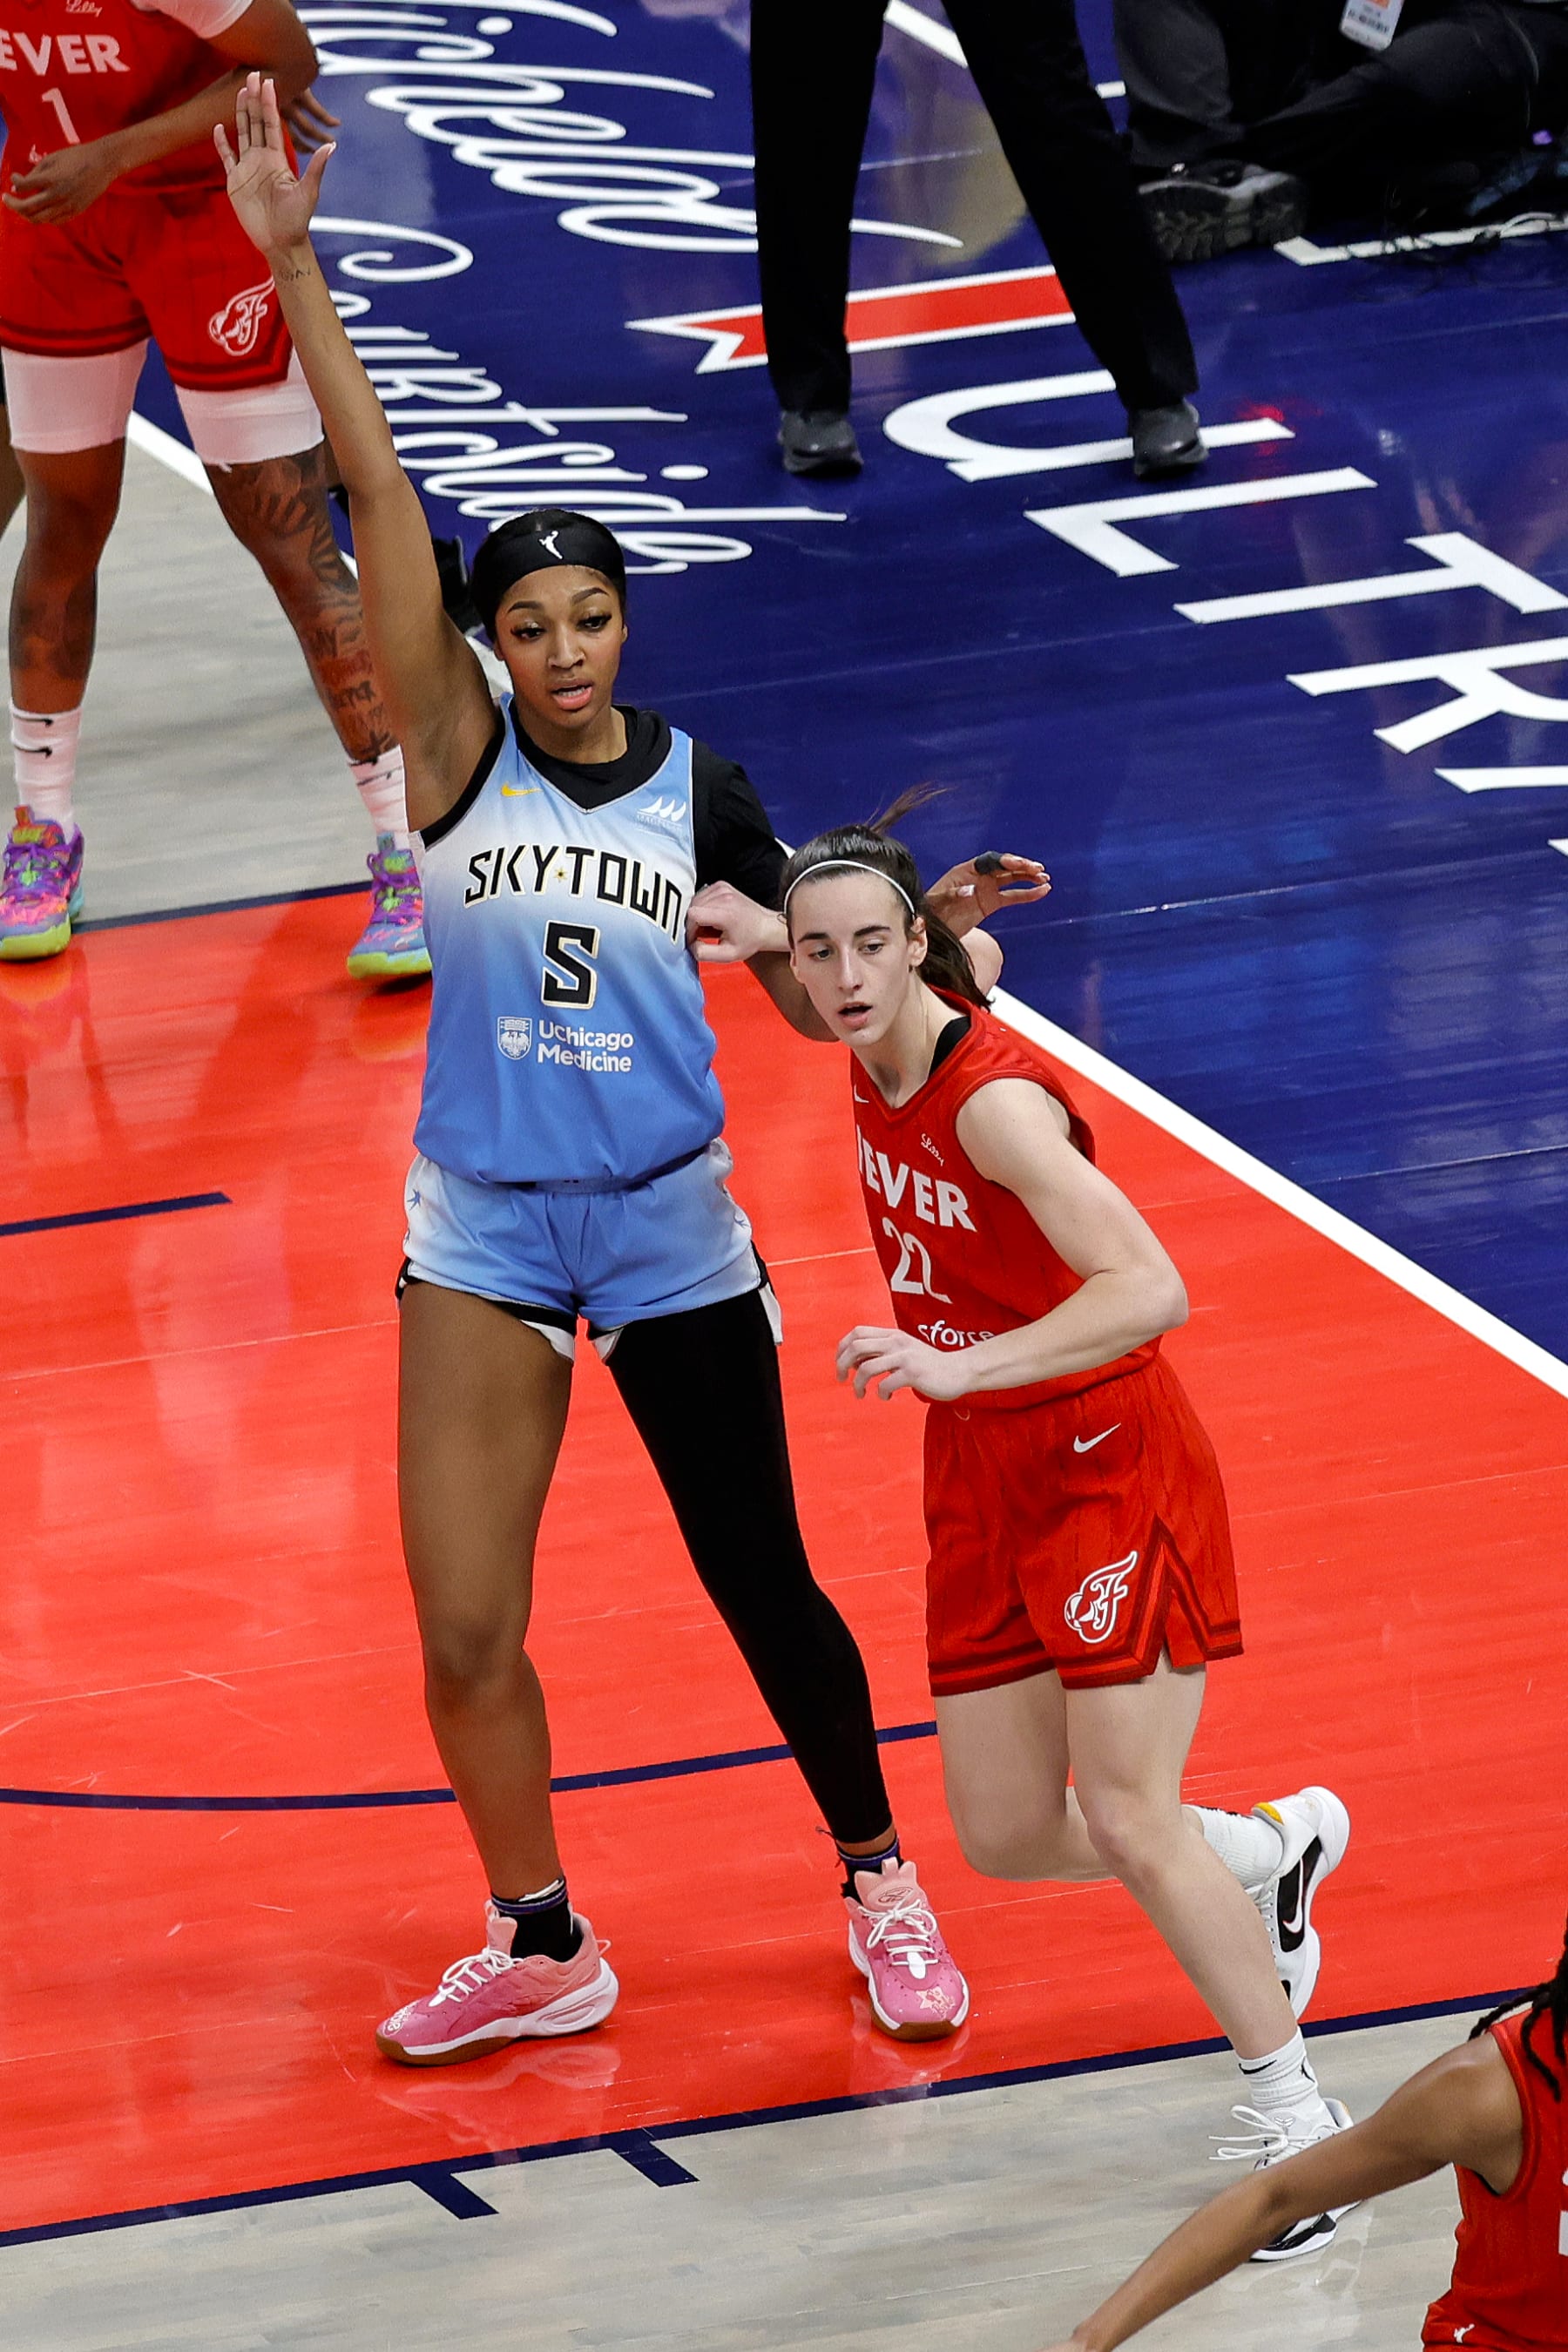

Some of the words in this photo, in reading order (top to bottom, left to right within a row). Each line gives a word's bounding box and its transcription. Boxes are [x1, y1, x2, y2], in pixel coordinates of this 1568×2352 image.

[41, 87, 81, 145] 1
[295, 0, 963, 253] ichelob
[541, 920, 601, 1010] 5
[537, 1043, 632, 1073] Medicine
[882, 1216, 954, 1305] 22
